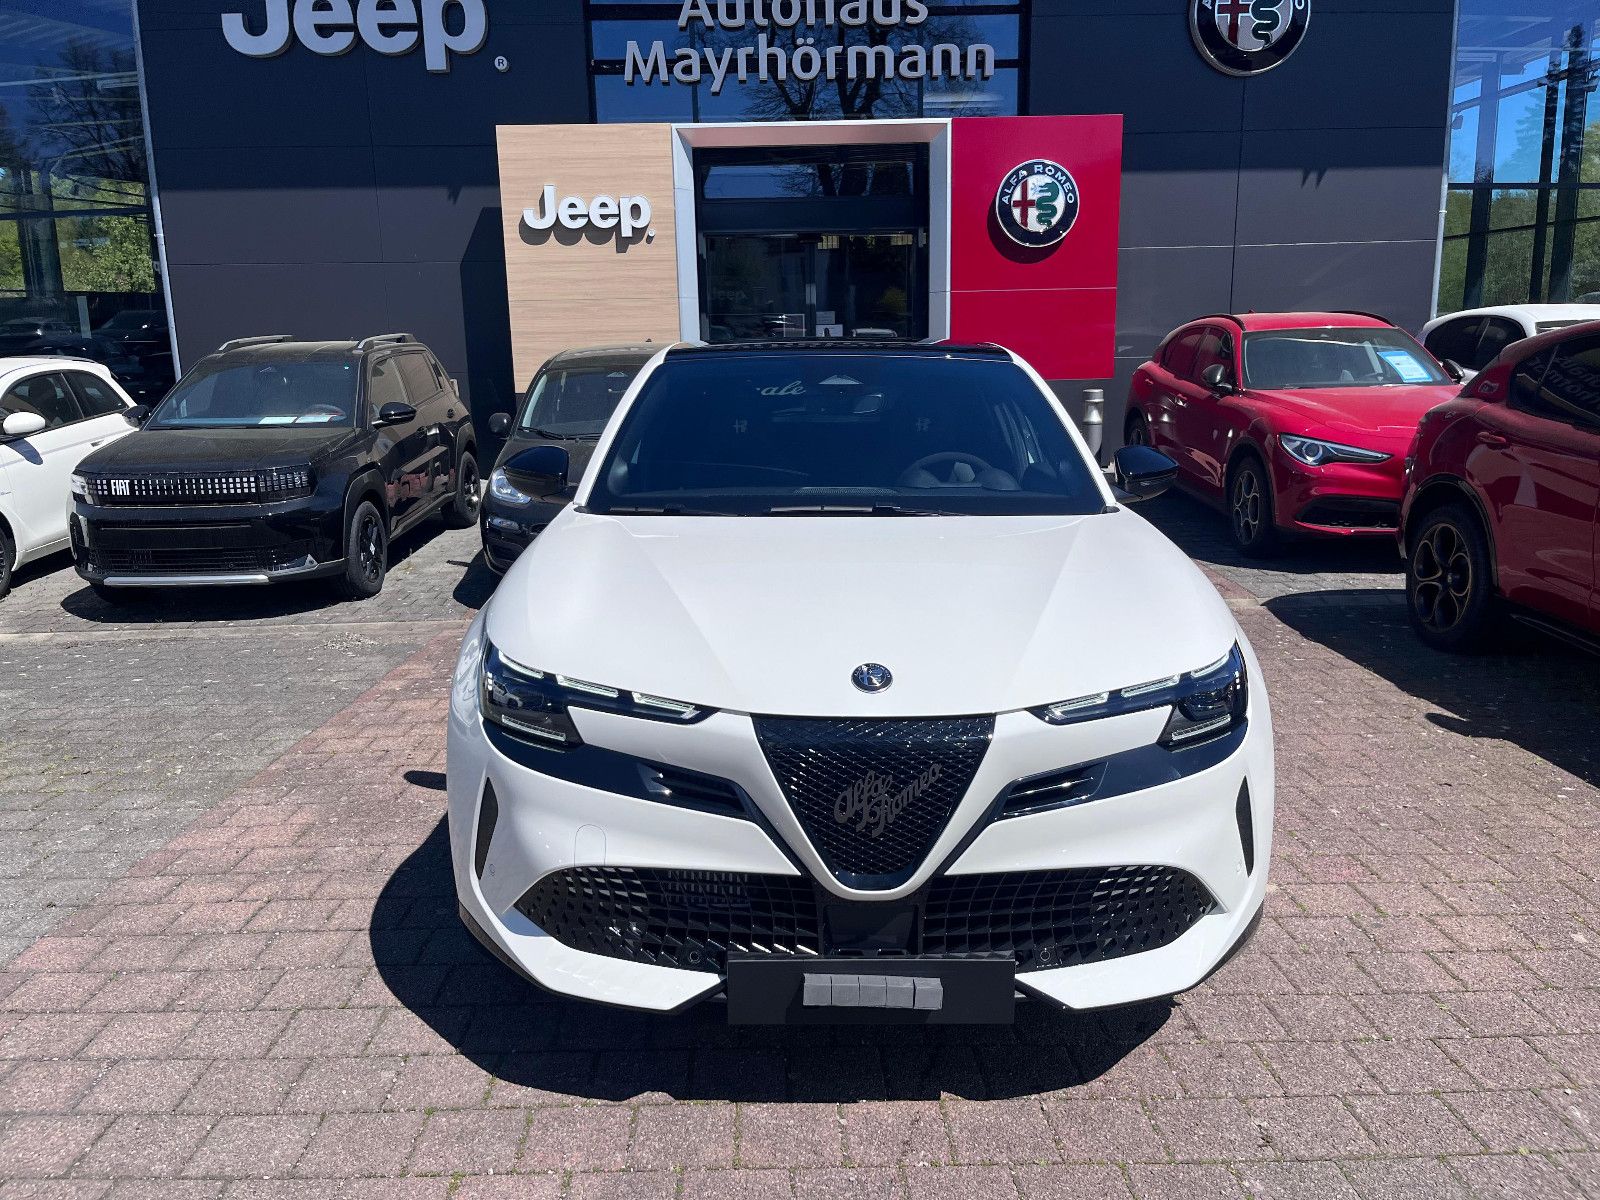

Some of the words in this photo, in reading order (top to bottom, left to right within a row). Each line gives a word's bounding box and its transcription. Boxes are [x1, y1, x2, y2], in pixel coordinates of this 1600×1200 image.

[221, 0, 487, 72] Jeep
[677, 0, 930, 28] Autohaus
[623, 33, 996, 94] Mayrhörmann
[522, 184, 652, 238] Jeep
[1001, 169, 1028, 205] ALFA
[1034, 164, 1075, 204] ROMEO
[110, 479, 131, 496] FIAT
[833, 769, 893, 832] Alfa
[868, 763, 943, 838] Romeo
